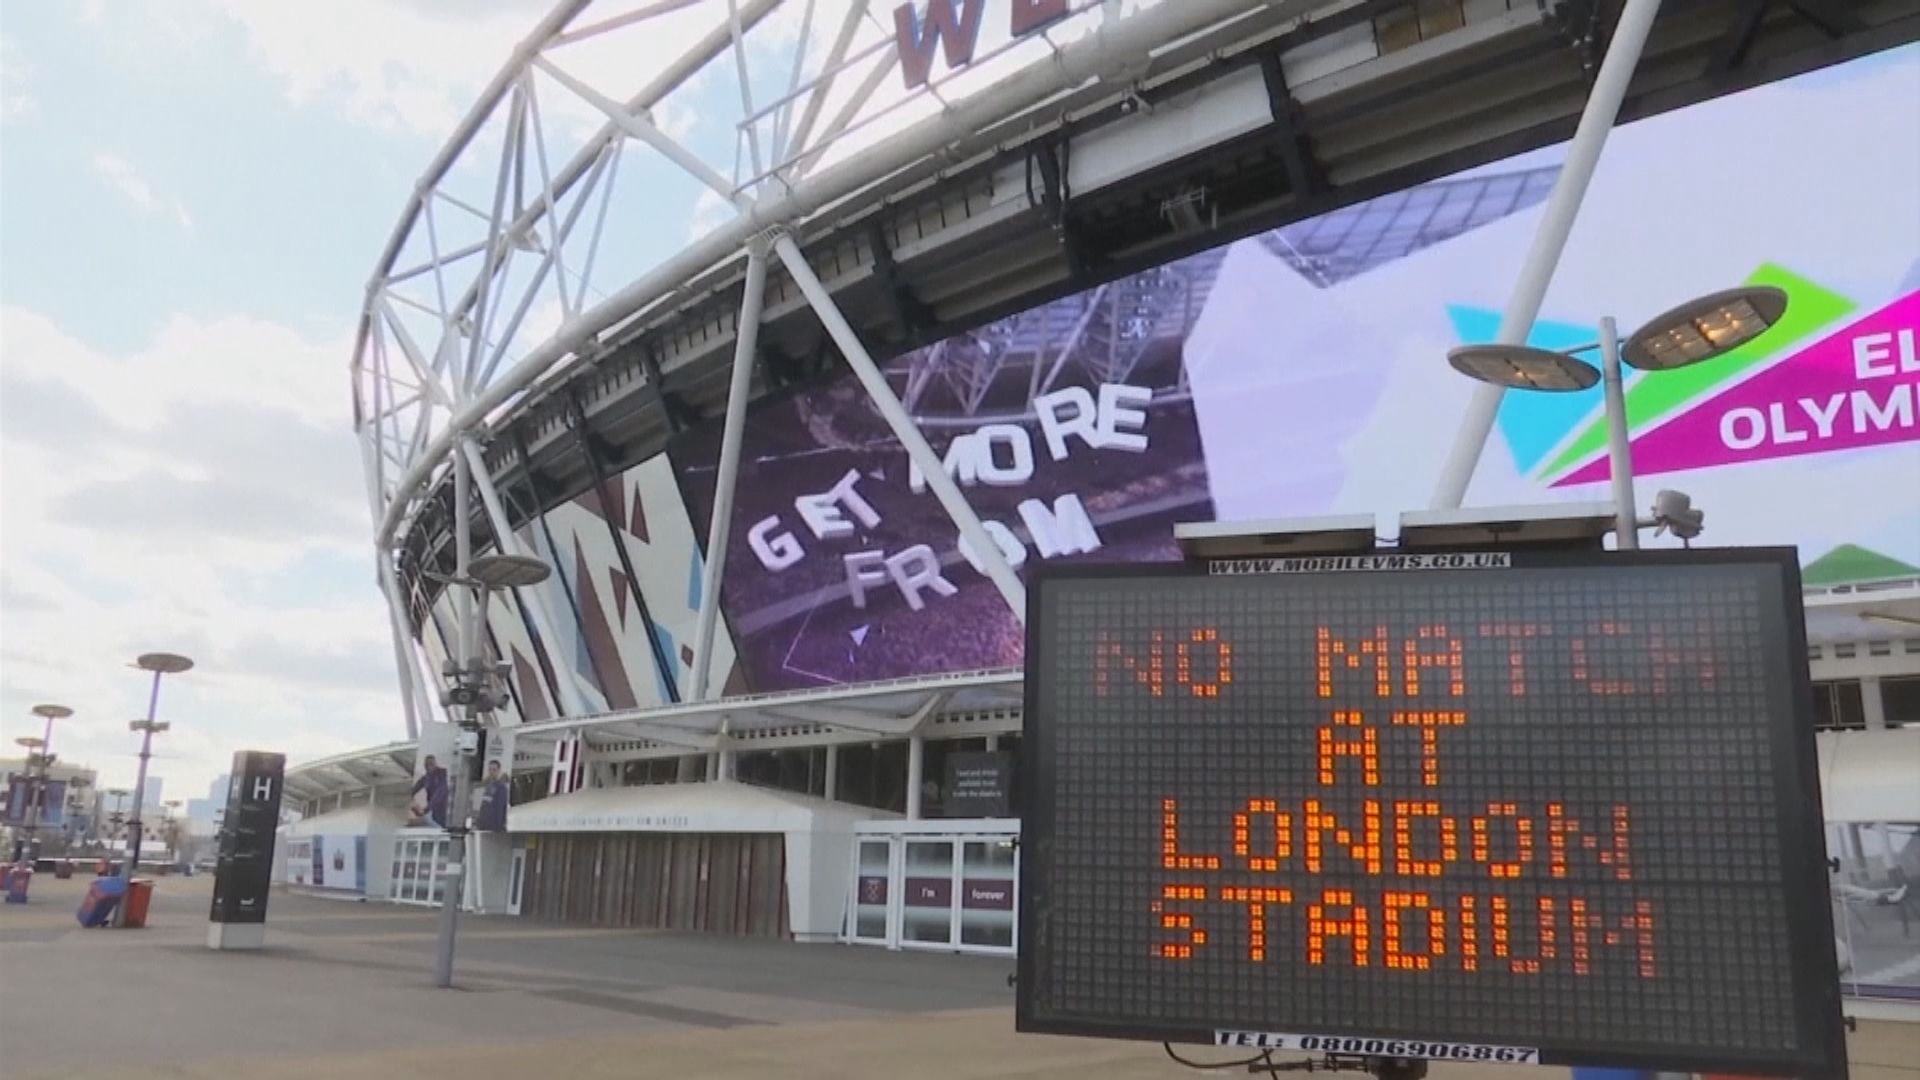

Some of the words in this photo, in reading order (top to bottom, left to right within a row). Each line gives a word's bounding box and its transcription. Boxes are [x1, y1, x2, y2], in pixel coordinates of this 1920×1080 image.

[747, 468, 883, 573] GET
[908, 382, 1153, 494] MORE
[1211, 552, 1508, 574] WWW.MOBILEVMS.CO.UK
[1097, 625, 1232, 696] NO
[1317, 621, 1718, 697] MATCH
[1317, 711, 1466, 786] AT
[253, 776, 272, 801] H
[1161, 799, 1633, 880] LONDON
[972, 889, 1005, 900] forever
[1151, 885, 1655, 977] STADIUM
[1217, 1031, 1283, 1048] TEL:
[1300, 1036, 1538, 1063] 08006906867
